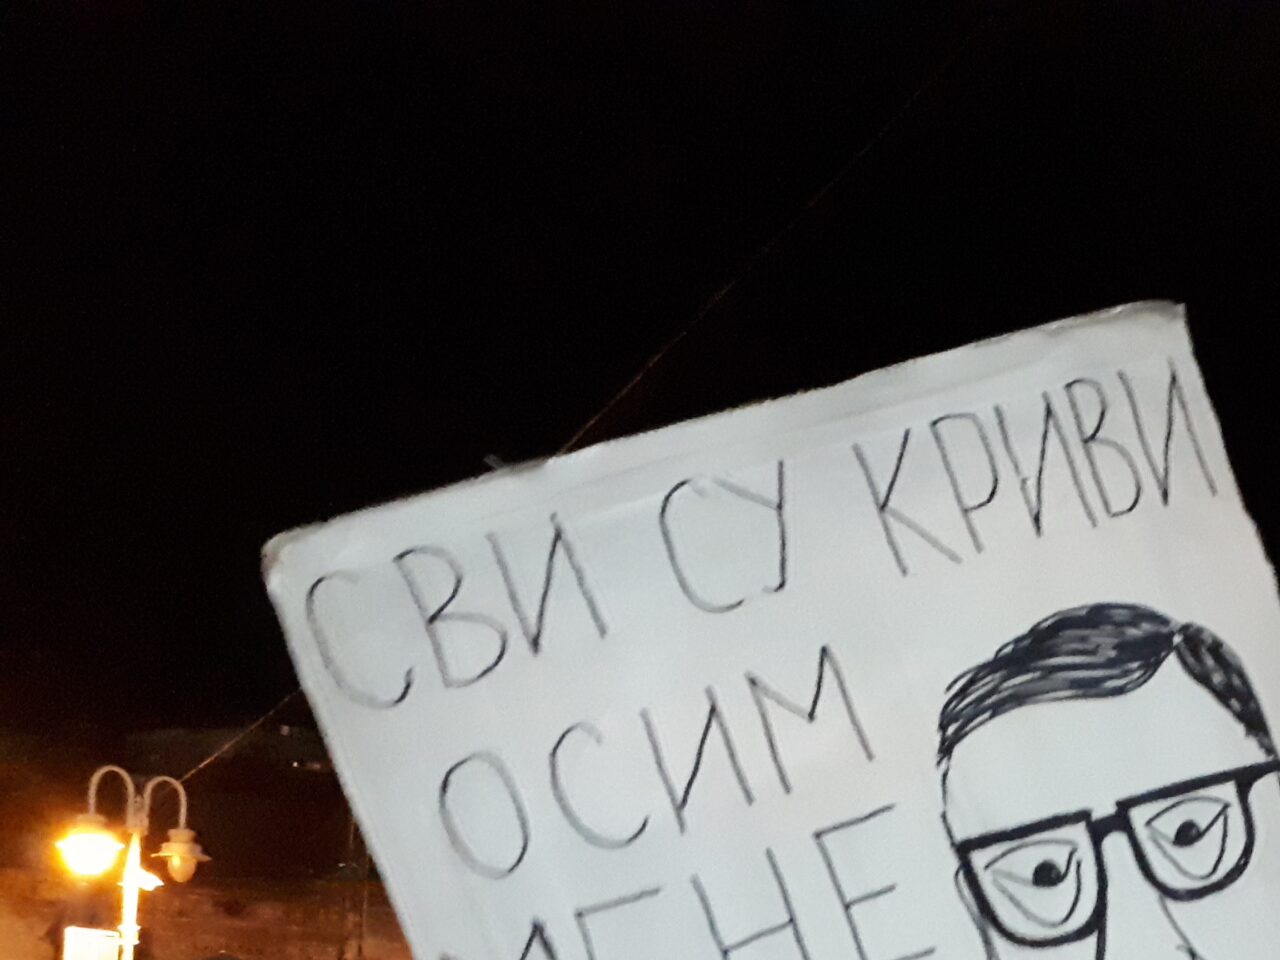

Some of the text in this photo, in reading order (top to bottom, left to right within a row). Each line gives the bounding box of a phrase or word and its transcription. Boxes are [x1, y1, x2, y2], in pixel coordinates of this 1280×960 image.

[305, 357, 1216, 709] СВИ СУ КРИВИ
[438, 645, 874, 878] ОСИМ
